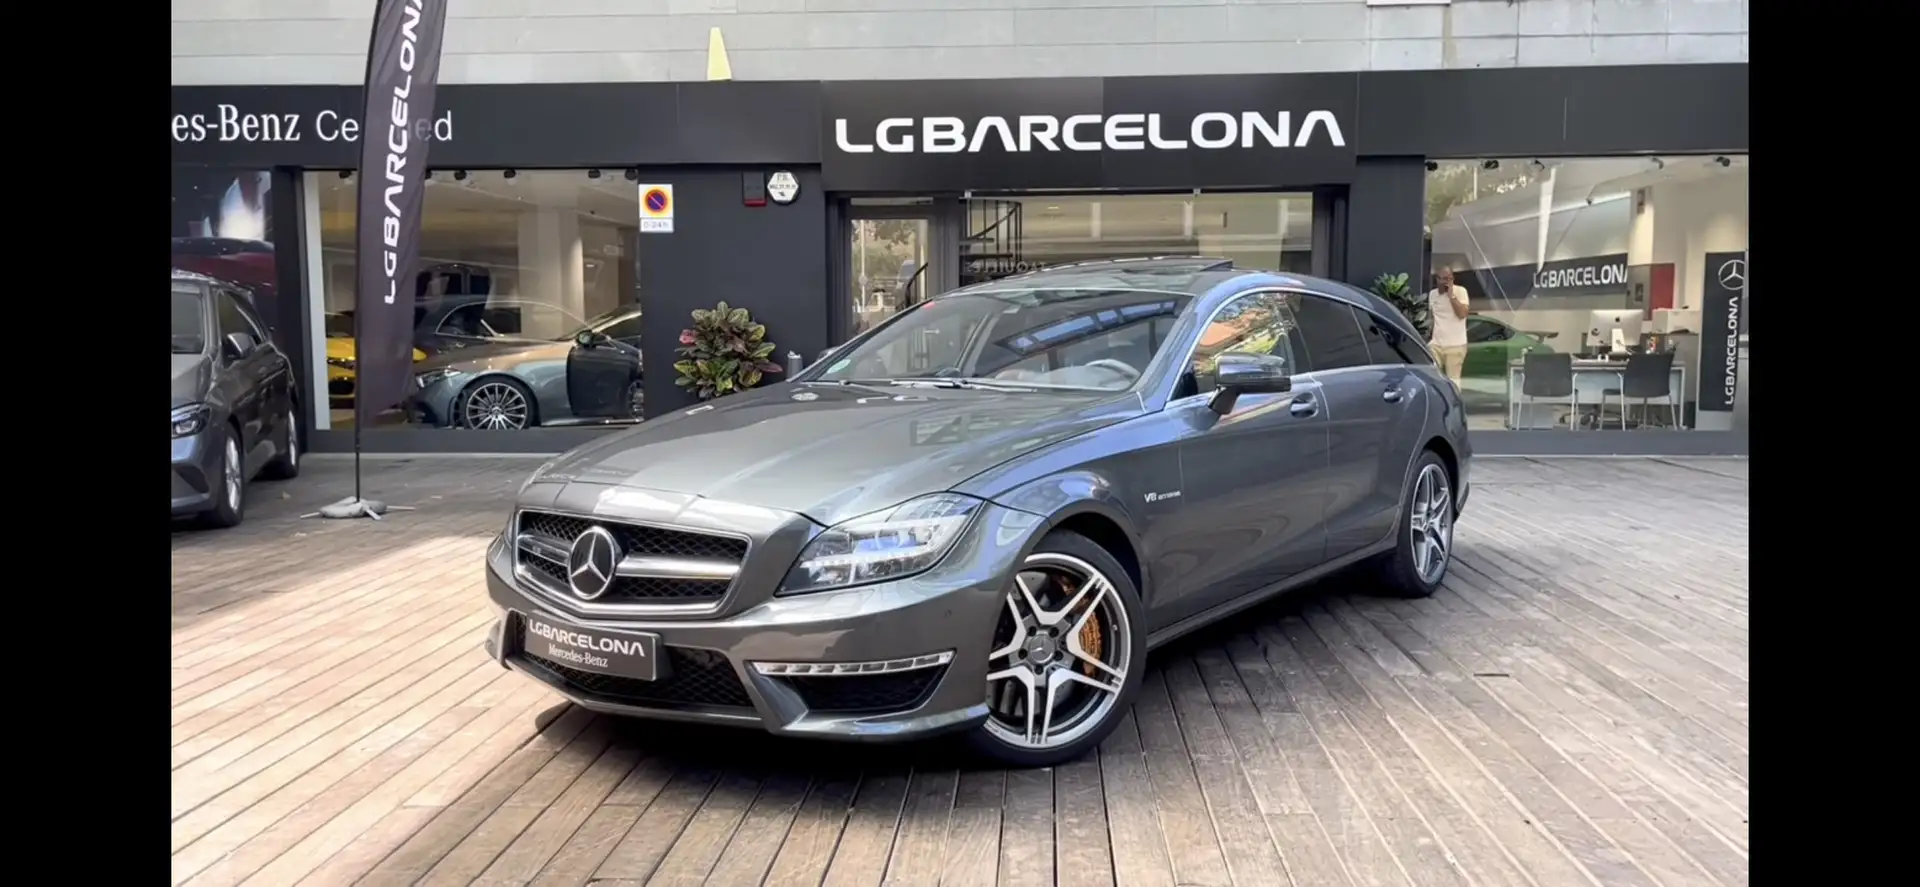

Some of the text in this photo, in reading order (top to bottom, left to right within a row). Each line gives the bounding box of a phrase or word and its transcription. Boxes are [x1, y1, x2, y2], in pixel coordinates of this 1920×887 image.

[835, 110, 1346, 153] LGBARCELONA
[1725, 296, 1738, 405] LGBARCELONA
[529, 619, 646, 657] LGBARCELONA
[548, 642, 608, 668] Mercedes-Benz
